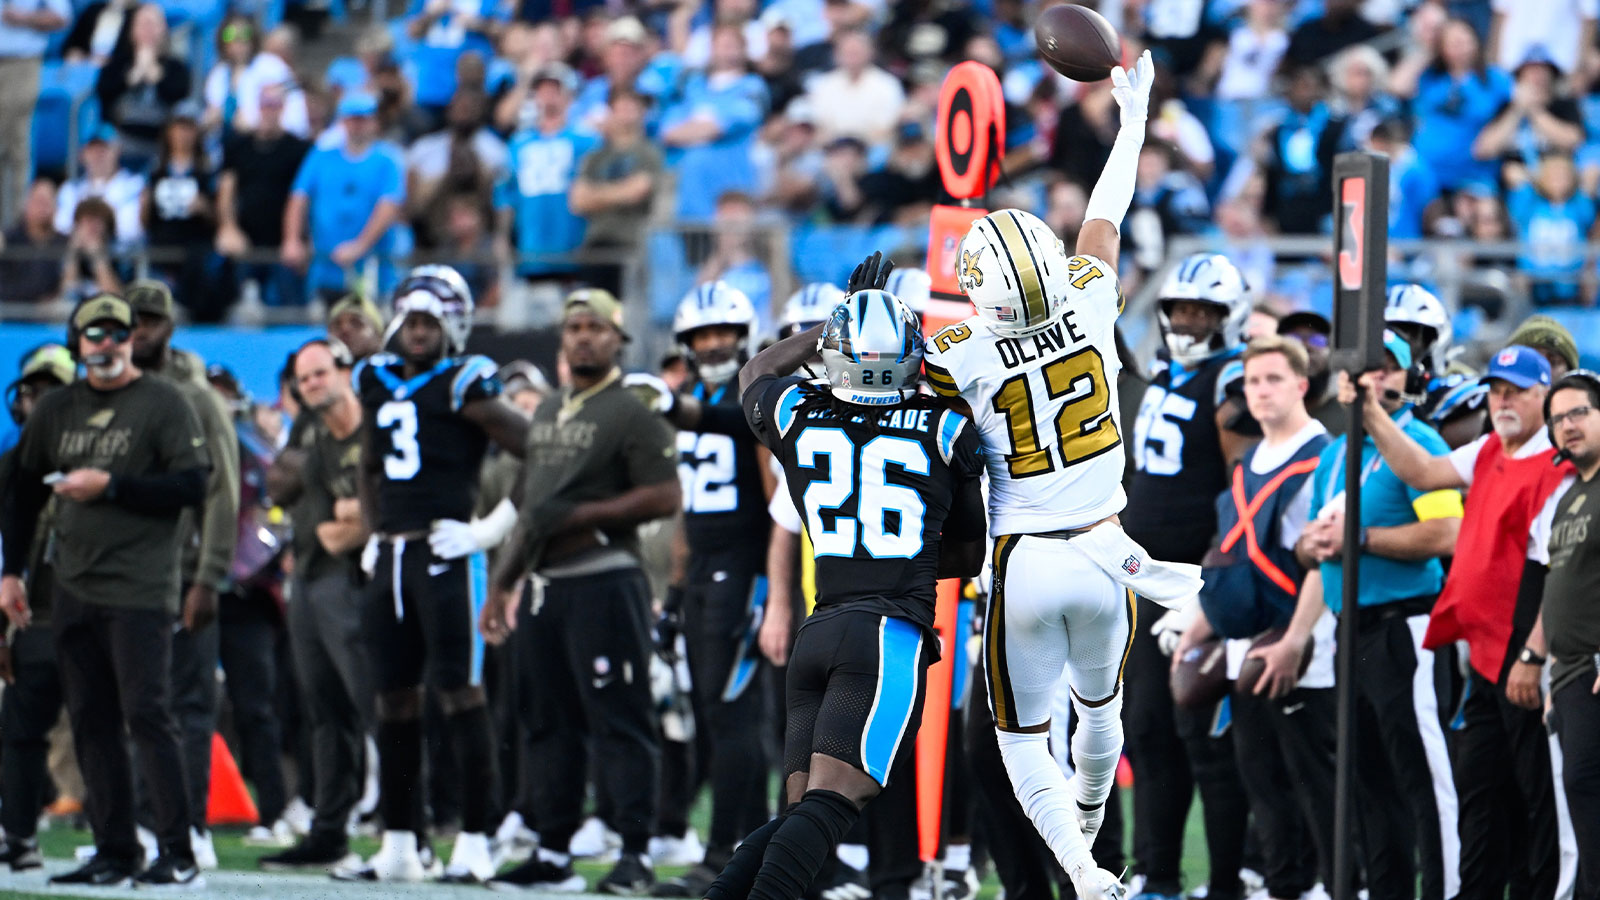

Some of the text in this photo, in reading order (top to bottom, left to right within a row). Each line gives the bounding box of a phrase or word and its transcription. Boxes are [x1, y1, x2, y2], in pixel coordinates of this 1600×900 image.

[995, 310, 1086, 369] OLAVE
[851, 394, 902, 406] PANTHERS
[862, 369, 893, 386] 26
[376, 401, 421, 480] 3
[991, 345, 1122, 480] 12
[795, 426, 931, 560] 26
